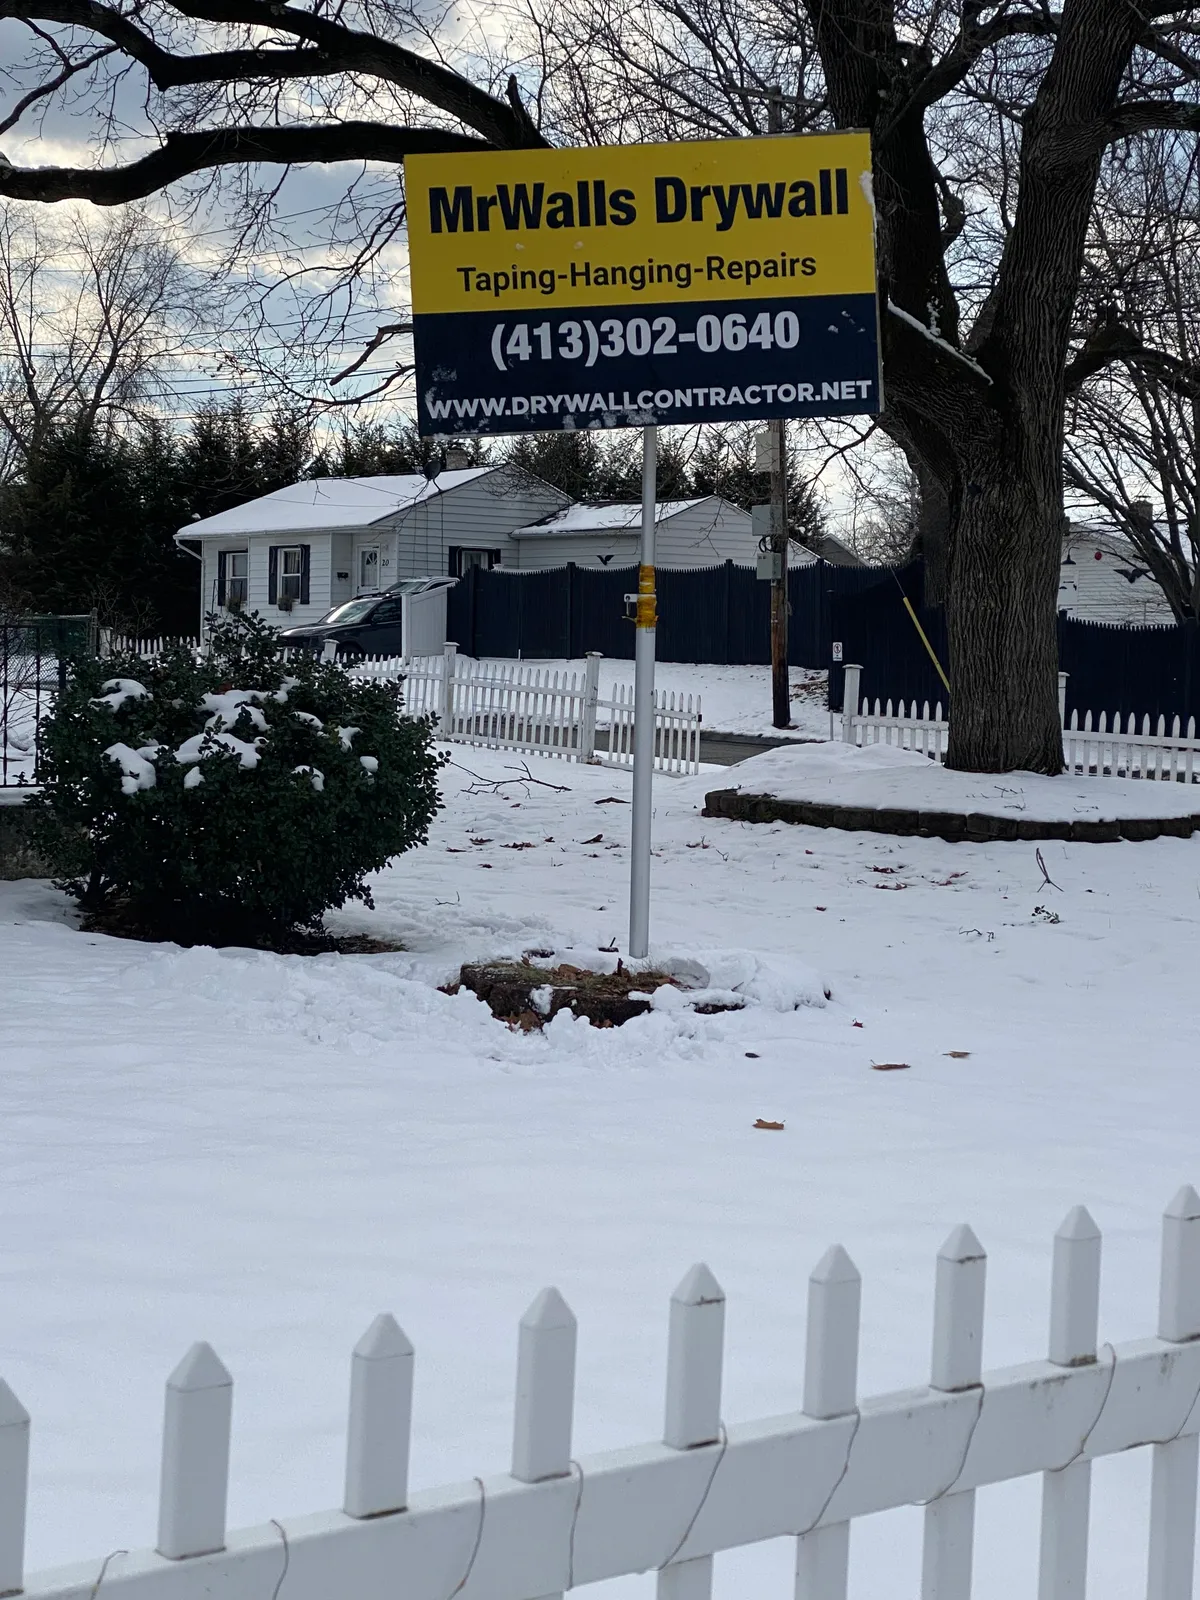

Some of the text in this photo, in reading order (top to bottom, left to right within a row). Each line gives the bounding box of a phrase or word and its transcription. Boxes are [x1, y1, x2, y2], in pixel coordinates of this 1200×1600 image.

[428, 167, 849, 233] MrWalls Drywall
[456, 251, 817, 297] Taping-Hanging-Repairs
[491, 310, 800, 371] (413)302-0640
[425, 379, 872, 419] WWW.DRYWALLCONTRACTOR.NET
